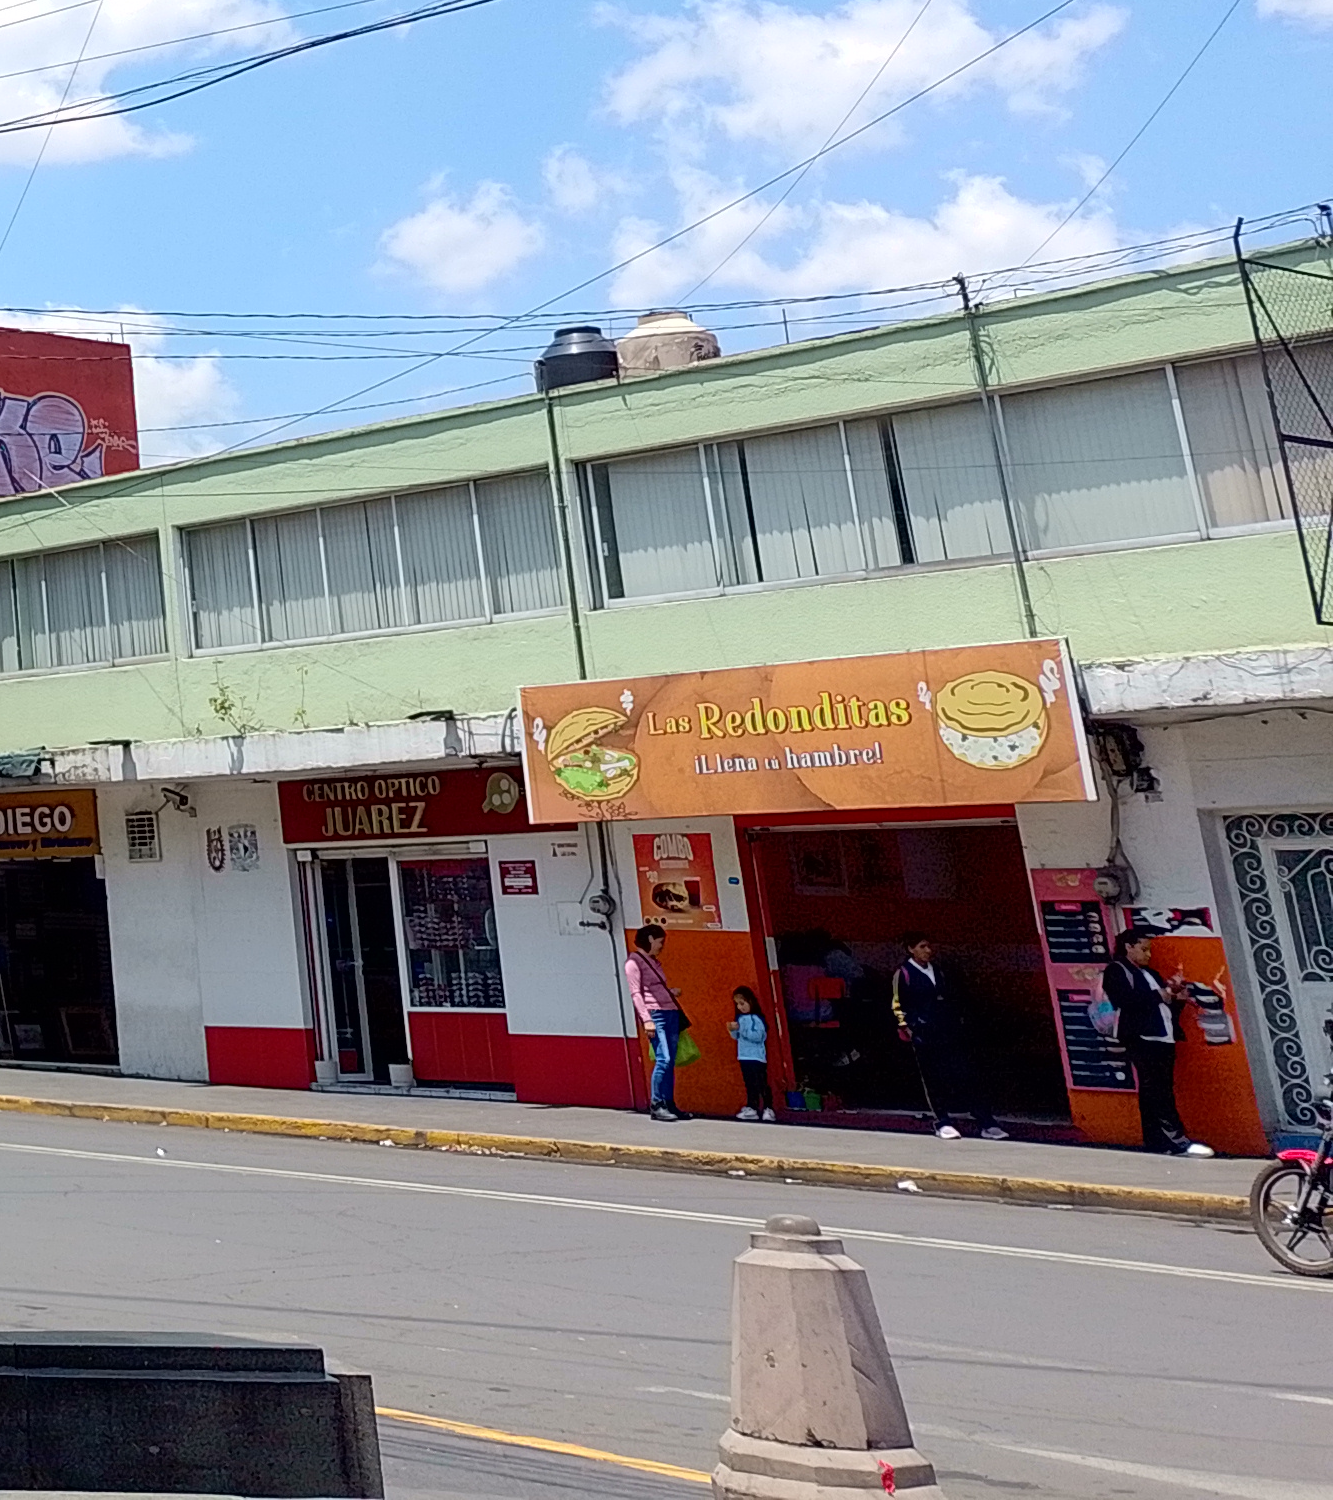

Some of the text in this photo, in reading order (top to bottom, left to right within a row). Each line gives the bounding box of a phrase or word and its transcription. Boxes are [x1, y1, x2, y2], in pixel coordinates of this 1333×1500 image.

[646, 691, 911, 740] Las Redonditas
[694, 753, 759, 775] ¡Llena
[784, 741, 884, 770] hambre!
[302, 775, 441, 802] CENTRO OPTICO
[321, 801, 428, 837] JUAREZ
[653, 833, 694, 861] COMBO
